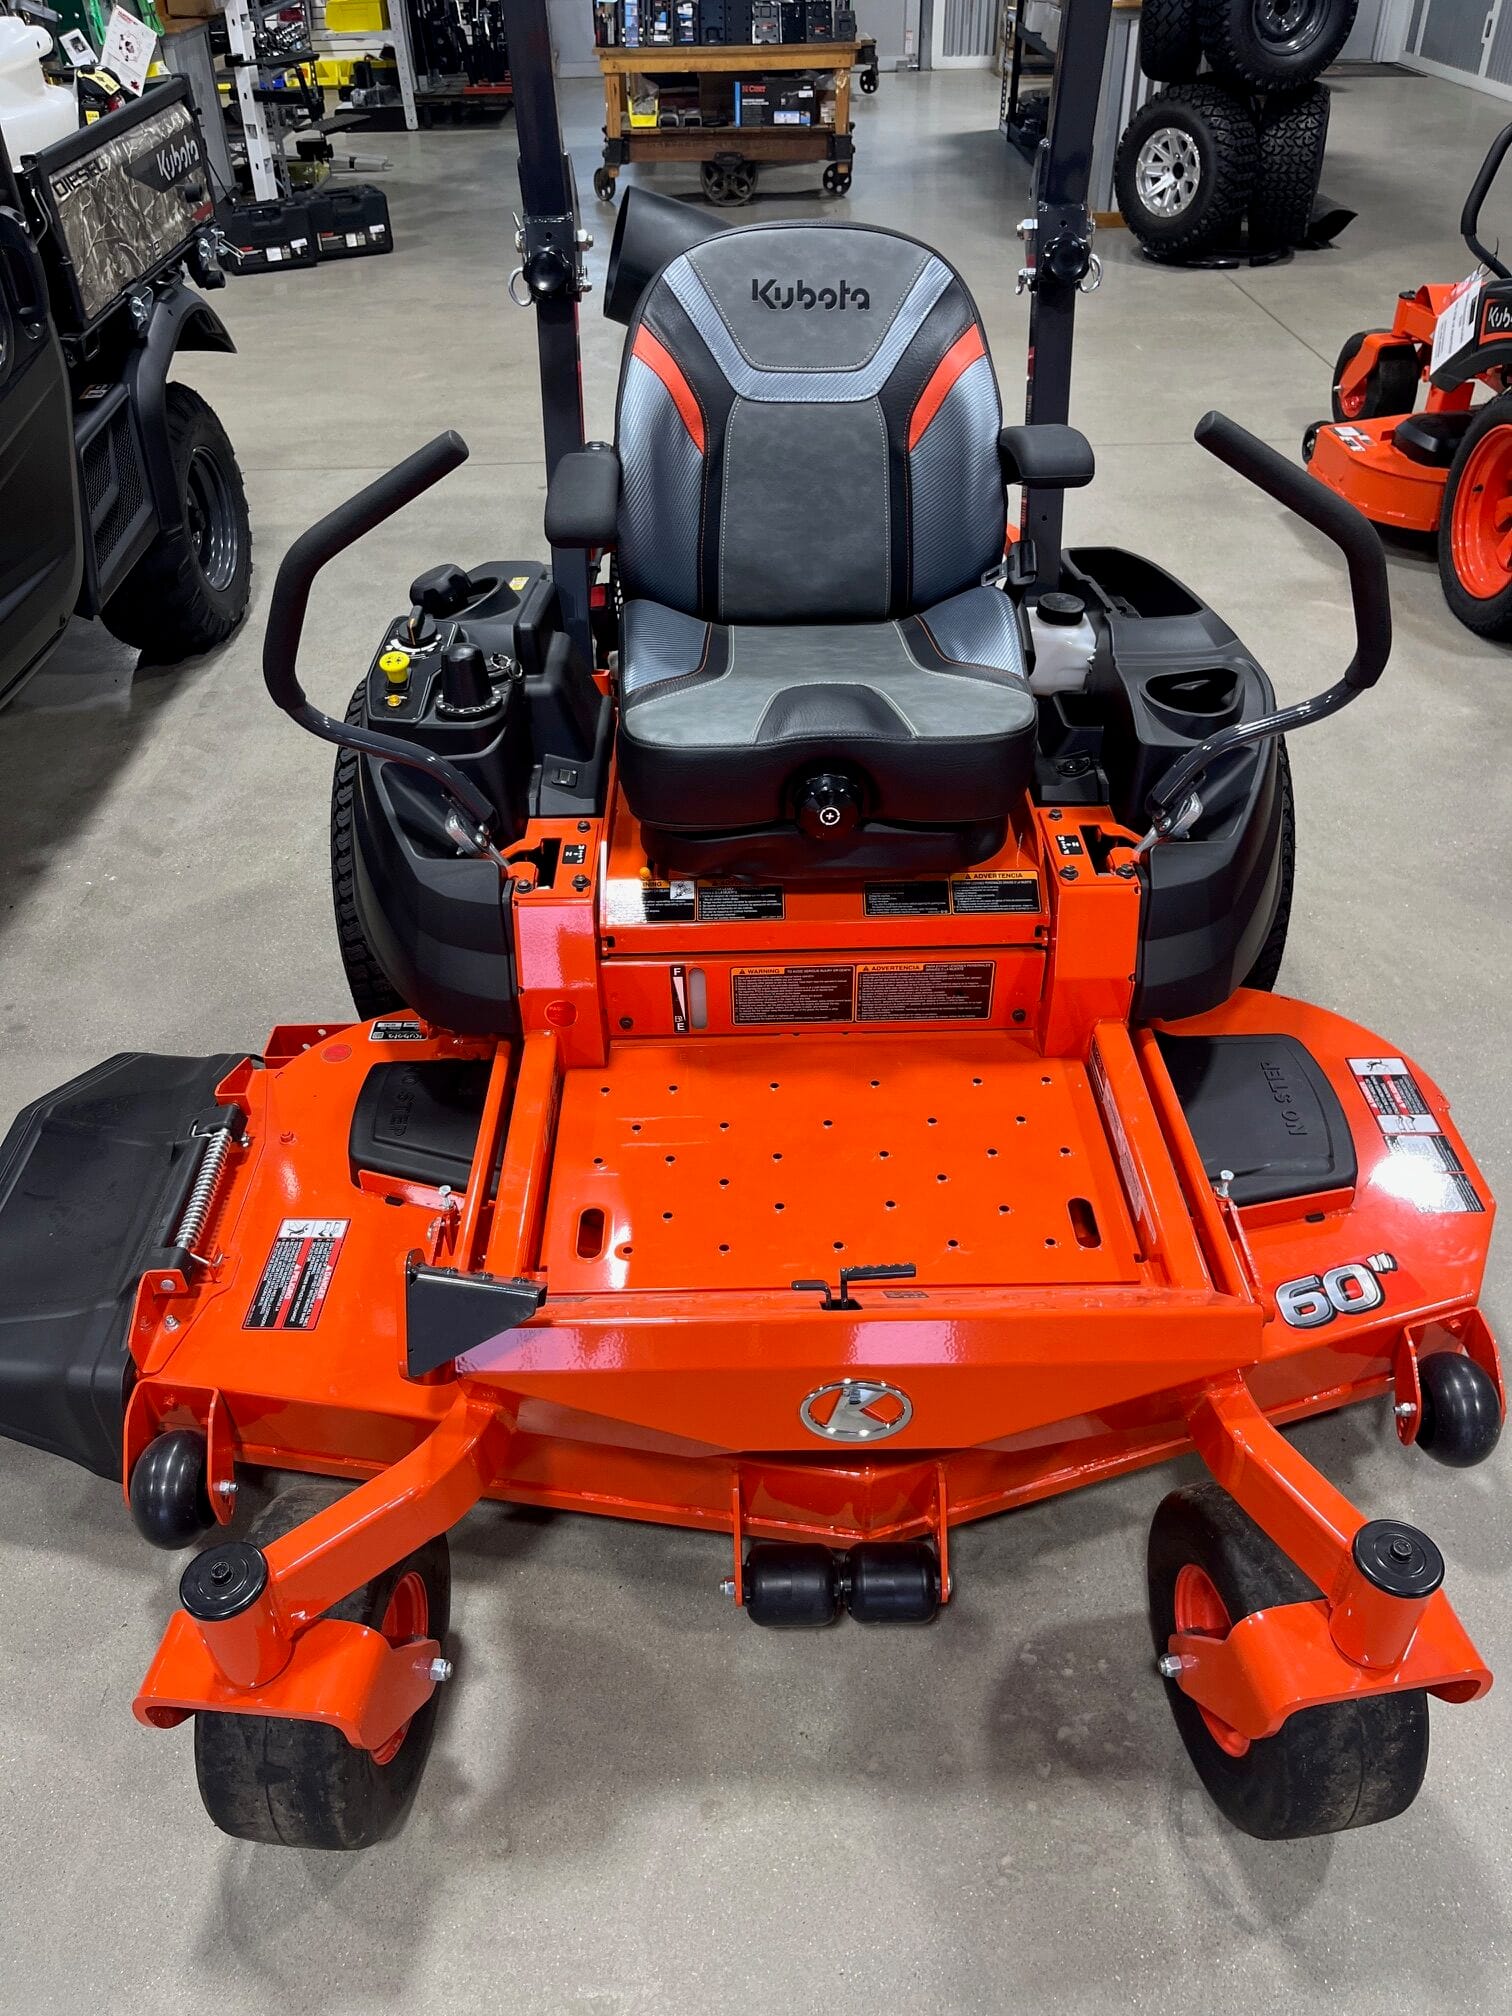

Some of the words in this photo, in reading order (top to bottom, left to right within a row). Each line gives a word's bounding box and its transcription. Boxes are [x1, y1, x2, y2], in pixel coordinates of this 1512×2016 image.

[156, 135, 199, 181] Kubota
[52, 160, 109, 198] DIESEL
[752, 278, 870, 310] Kubota
[1488, 307, 1512, 328] Kub
[674, 968, 681, 976] F
[677, 1022, 685, 1030] E
[284, 1270, 301, 1300] PELIGRO
[316, 1270, 332, 1300] DANGER
